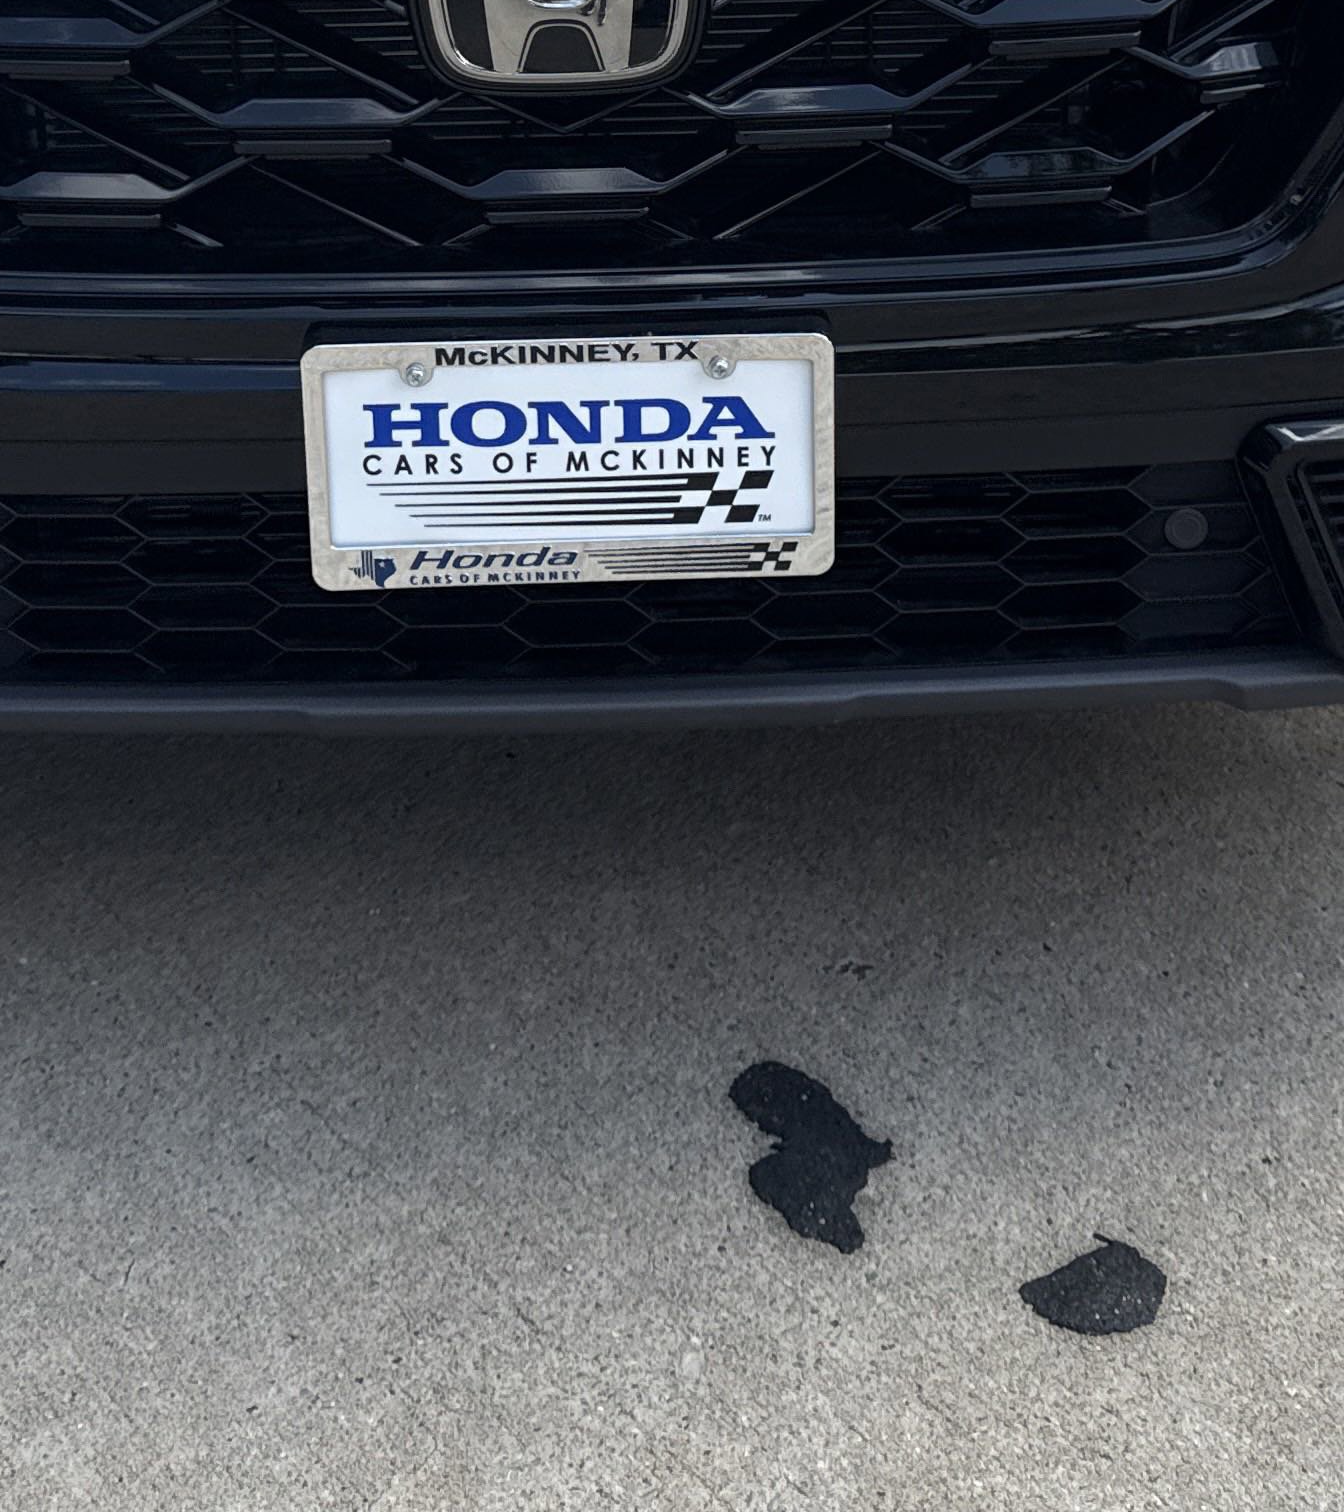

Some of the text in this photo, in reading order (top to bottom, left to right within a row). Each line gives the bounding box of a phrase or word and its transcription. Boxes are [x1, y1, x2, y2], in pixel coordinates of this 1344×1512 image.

[435, 341, 699, 366] McKINNEY, TX
[363, 396, 776, 448] HONDA
[363, 445, 776, 475] CARS OF MCKINNEY
[758, 513, 772, 522] TM
[409, 546, 579, 570] Honda
[409, 570, 581, 586] CARS OF MCKINNEY
